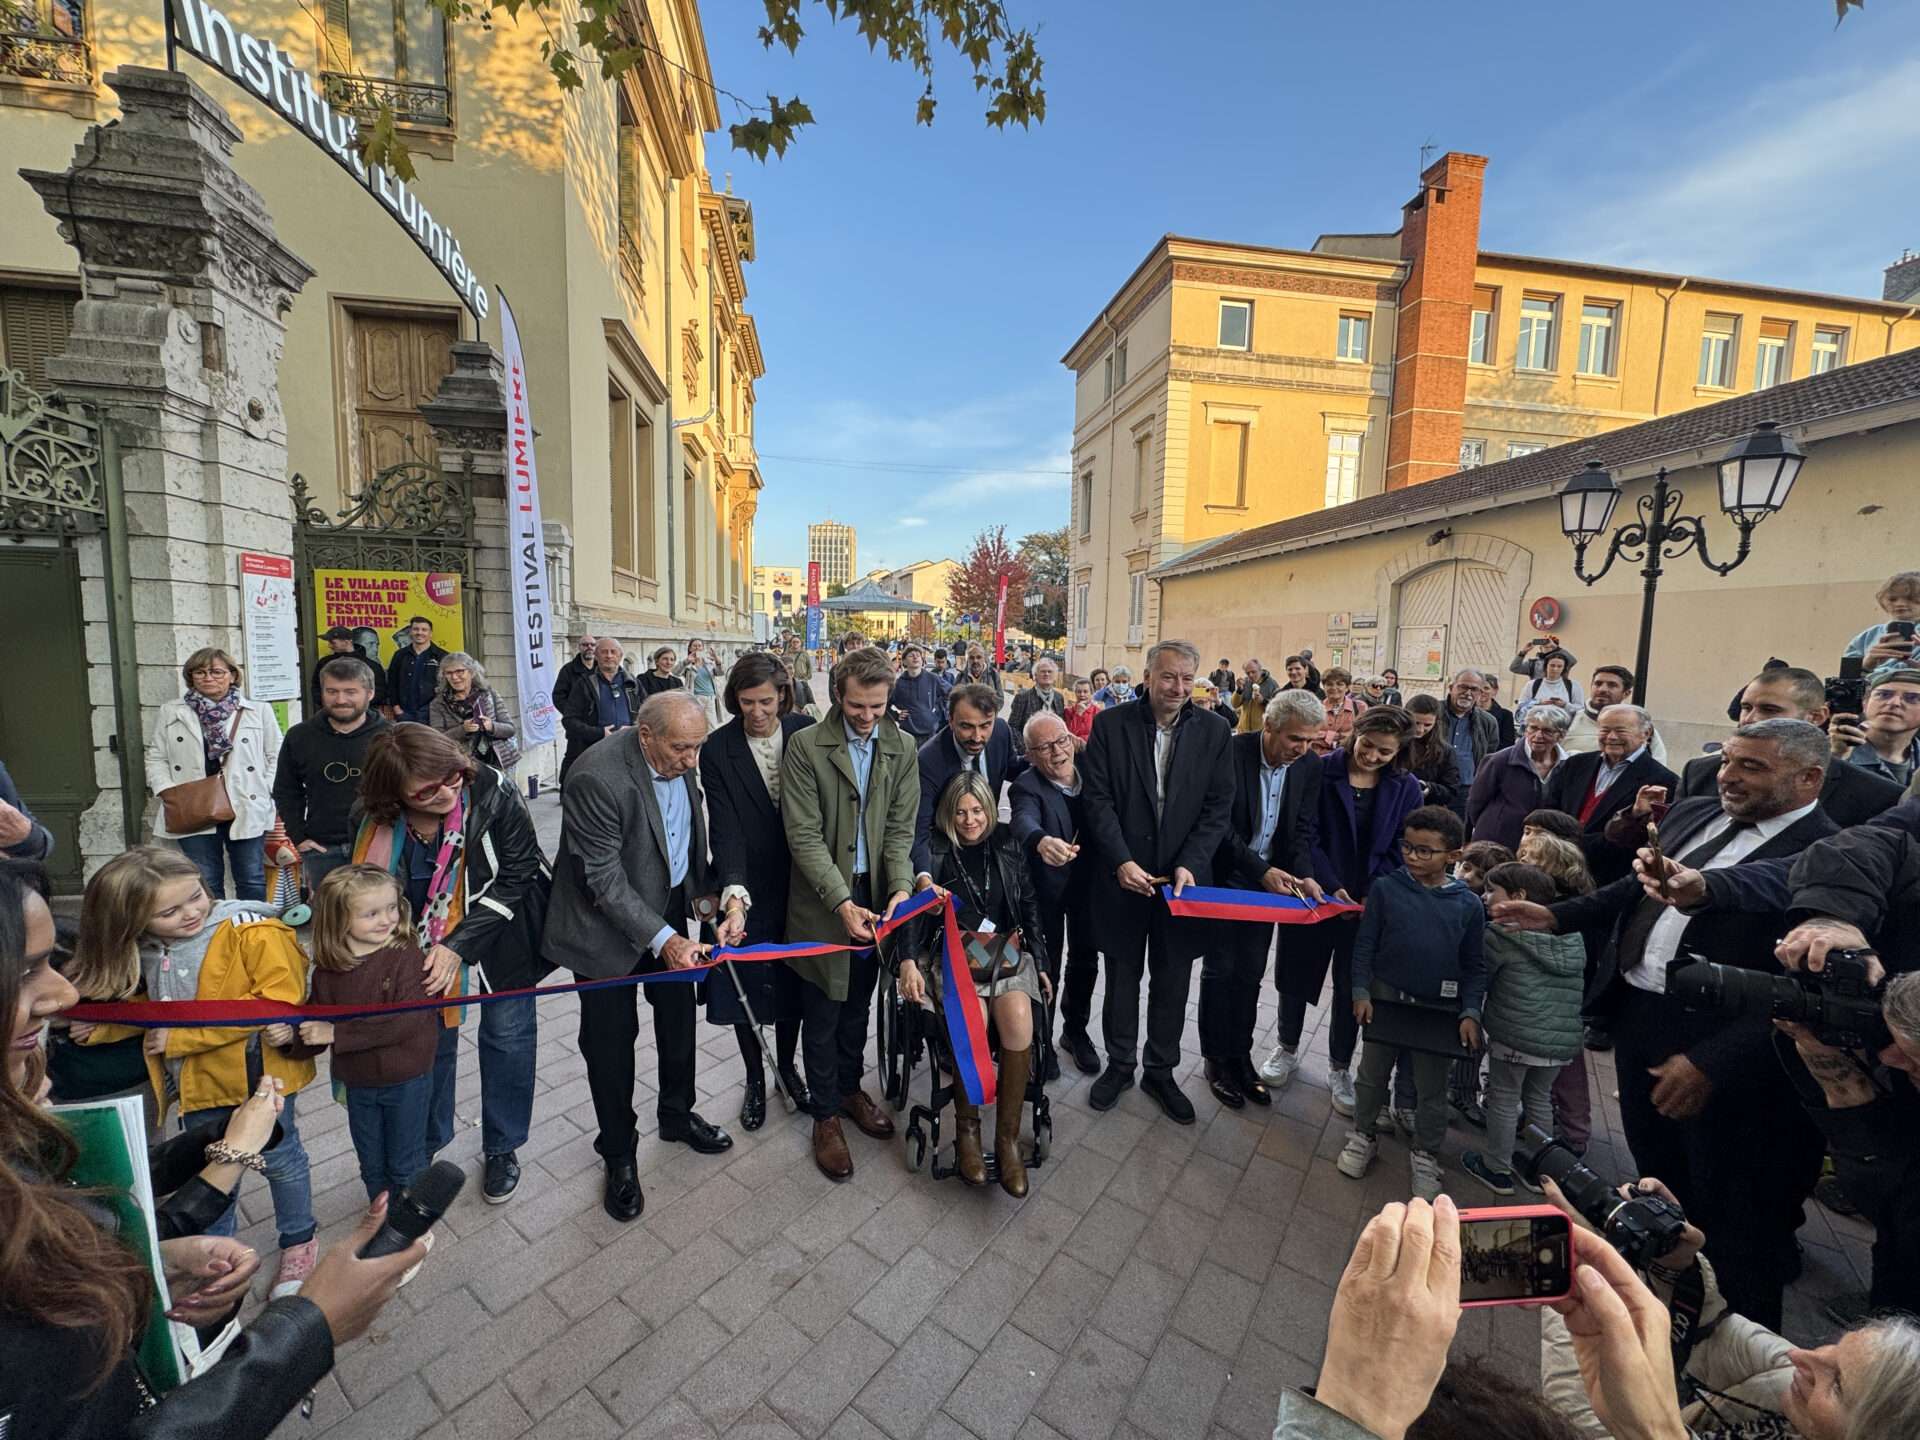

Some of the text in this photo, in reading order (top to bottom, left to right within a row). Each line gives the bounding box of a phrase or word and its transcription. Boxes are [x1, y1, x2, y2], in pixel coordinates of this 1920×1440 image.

[378, 166, 489, 319] Lumière
[324, 577, 409, 590] LE VILLAGE
[386, 591, 406, 603] DU
[522, 521, 544, 669] FESTIVAL
[326, 603, 397, 615] FESTIVAL
